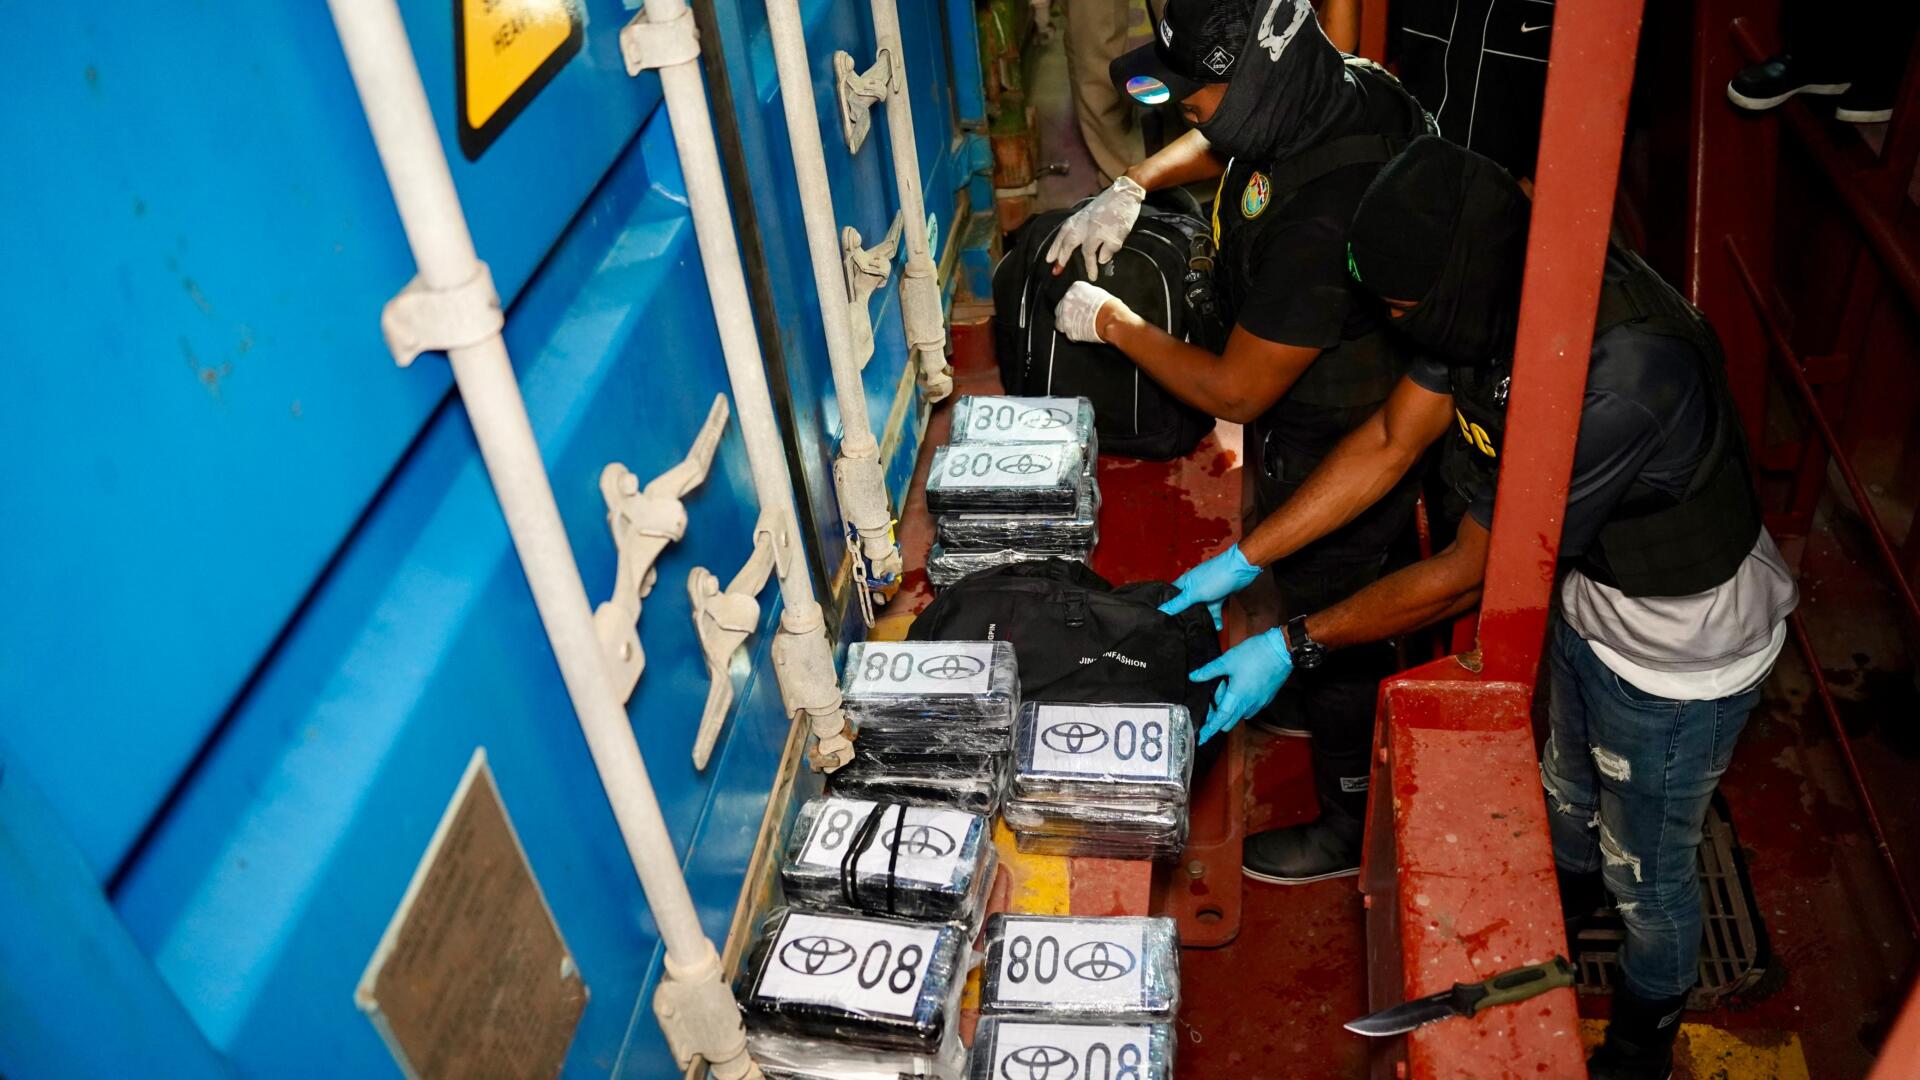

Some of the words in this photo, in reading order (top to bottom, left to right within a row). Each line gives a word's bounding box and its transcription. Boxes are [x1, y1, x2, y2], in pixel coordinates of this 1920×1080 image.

[1113, 719, 1164, 762] 08
[857, 939, 924, 995] 08
[1085, 1042, 1142, 1080] 08
